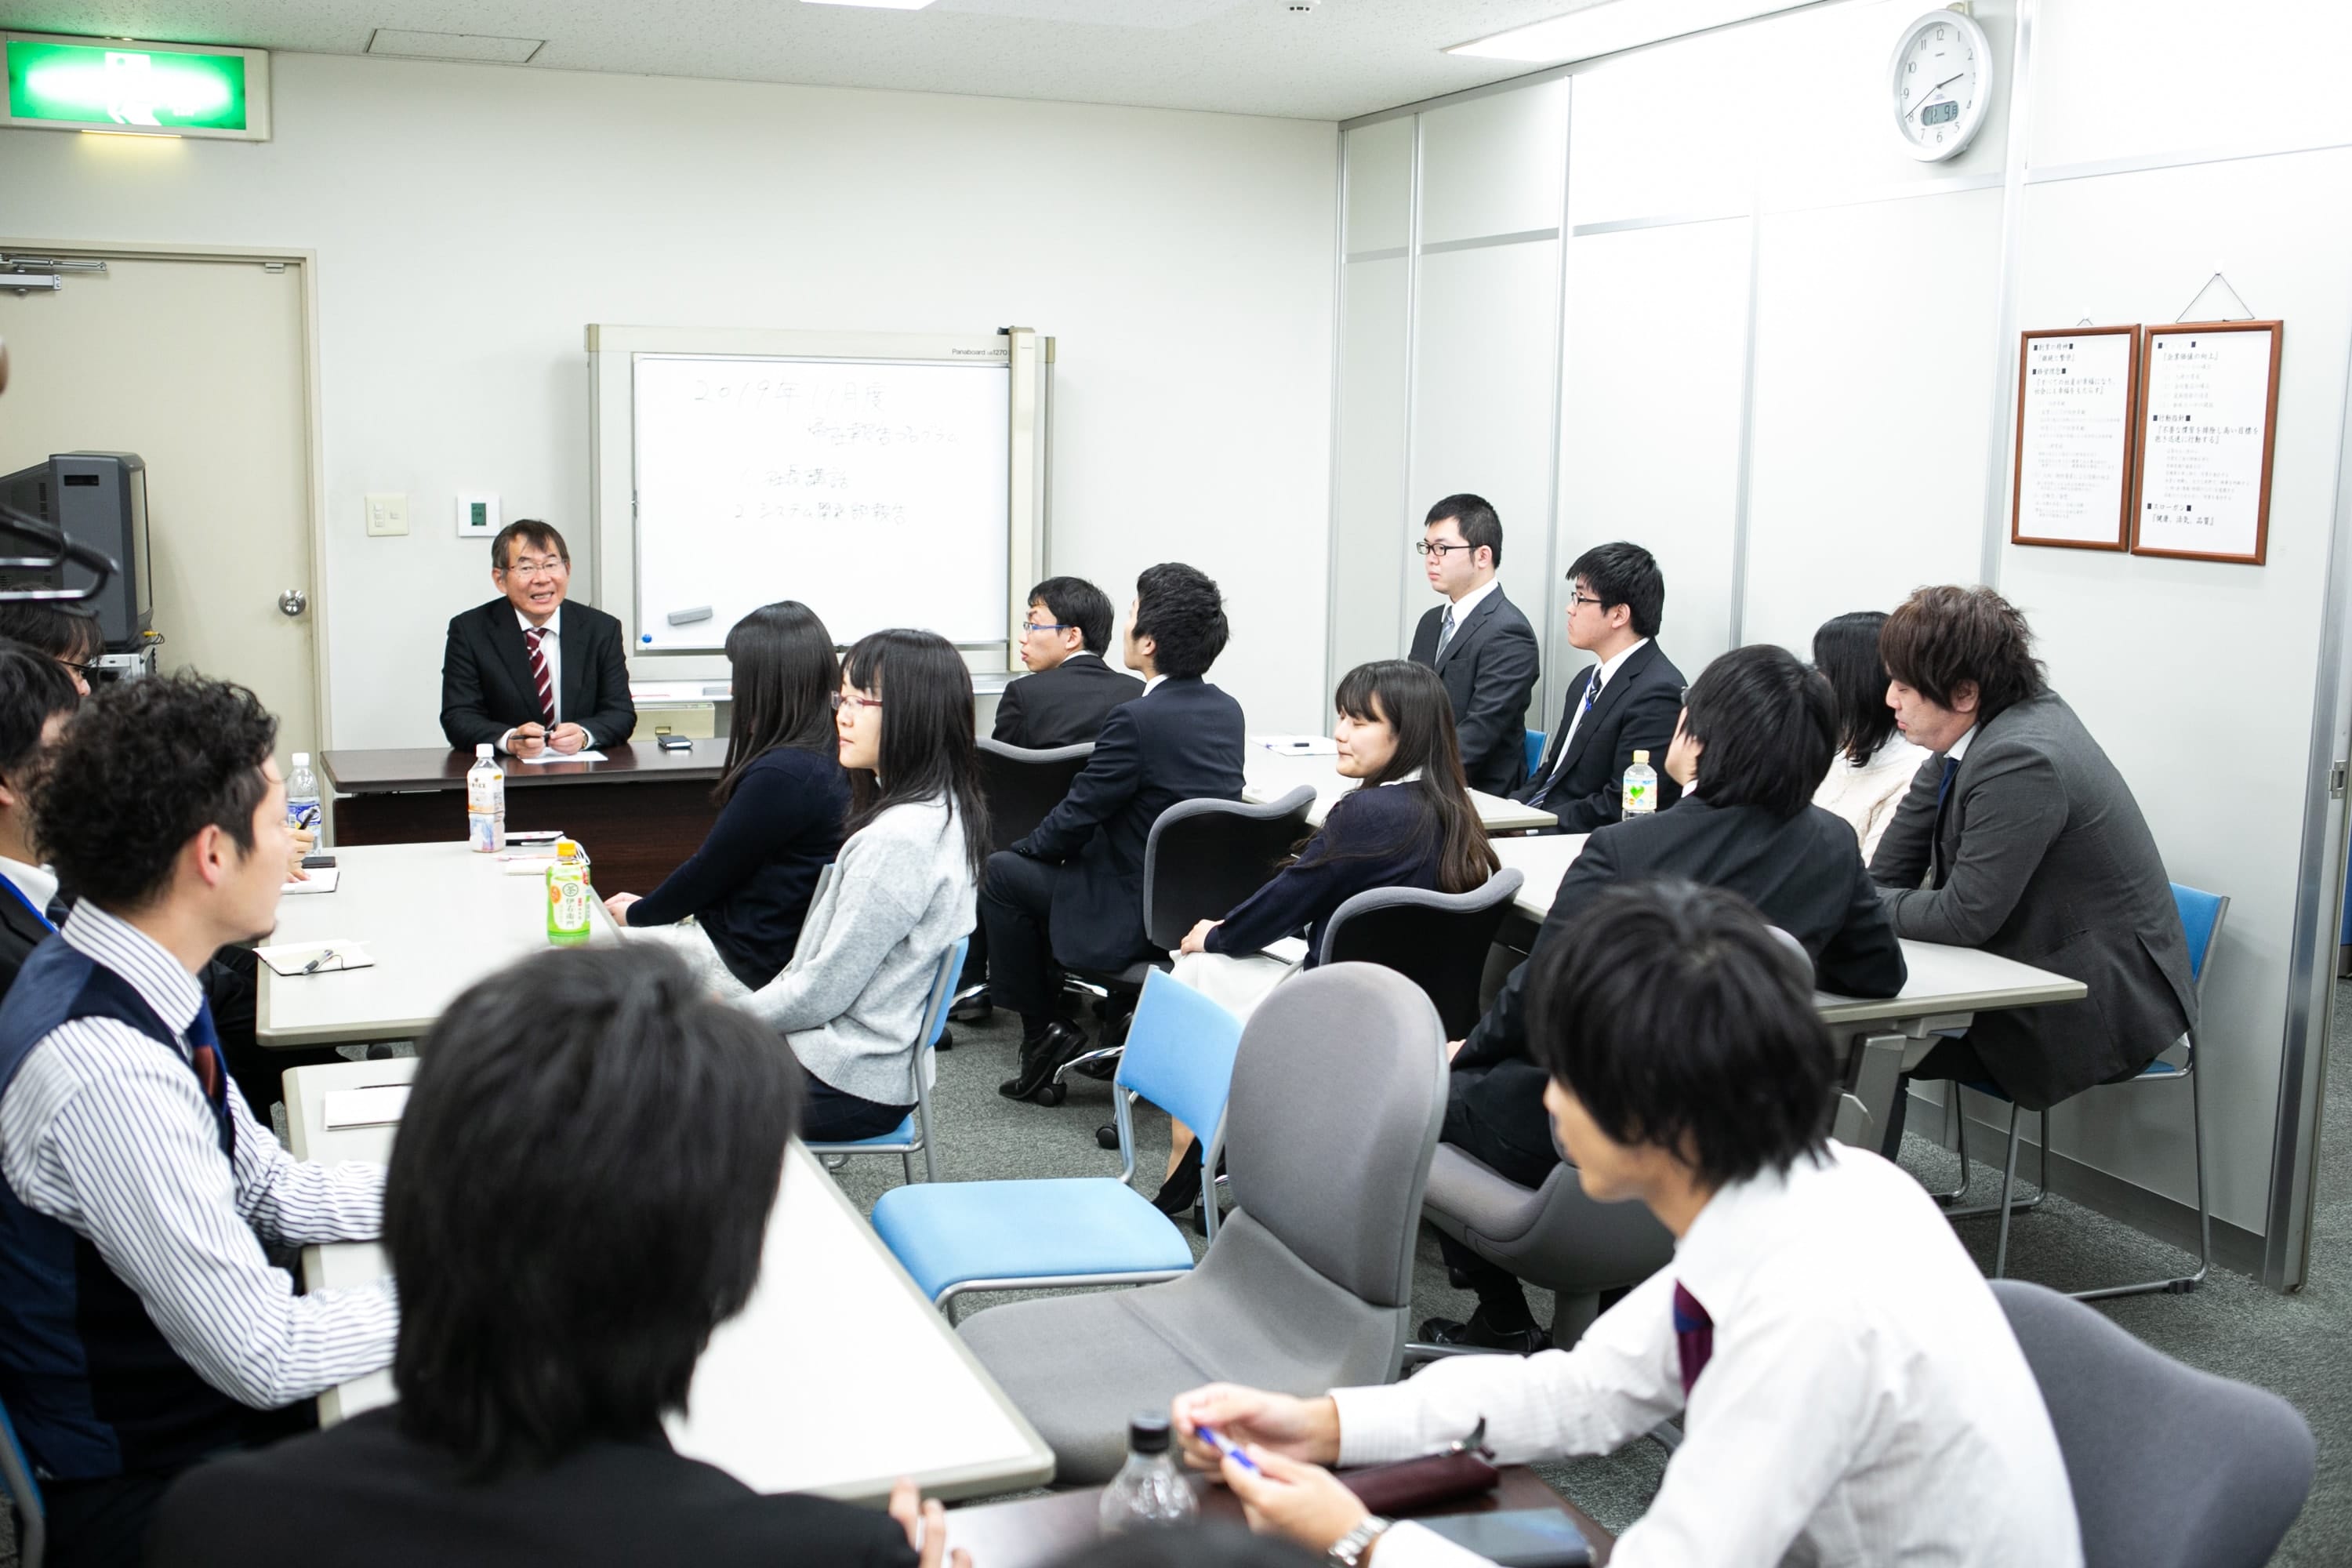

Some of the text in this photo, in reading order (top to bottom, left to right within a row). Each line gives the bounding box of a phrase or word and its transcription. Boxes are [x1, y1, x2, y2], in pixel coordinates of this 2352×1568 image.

[1936, 28, 1944, 41] 12
[1920, 39, 1926, 50] 11
[1968, 49, 1973, 60] 2
[1907, 63, 1917, 74] 10
[1903, 88, 1910, 99] 9
[1907, 113, 1915, 123] 8
[1921, 128, 1926, 140] 7
[1936, 132, 1943, 143] 6
[694, 376, 887, 414] 2019年11月度
